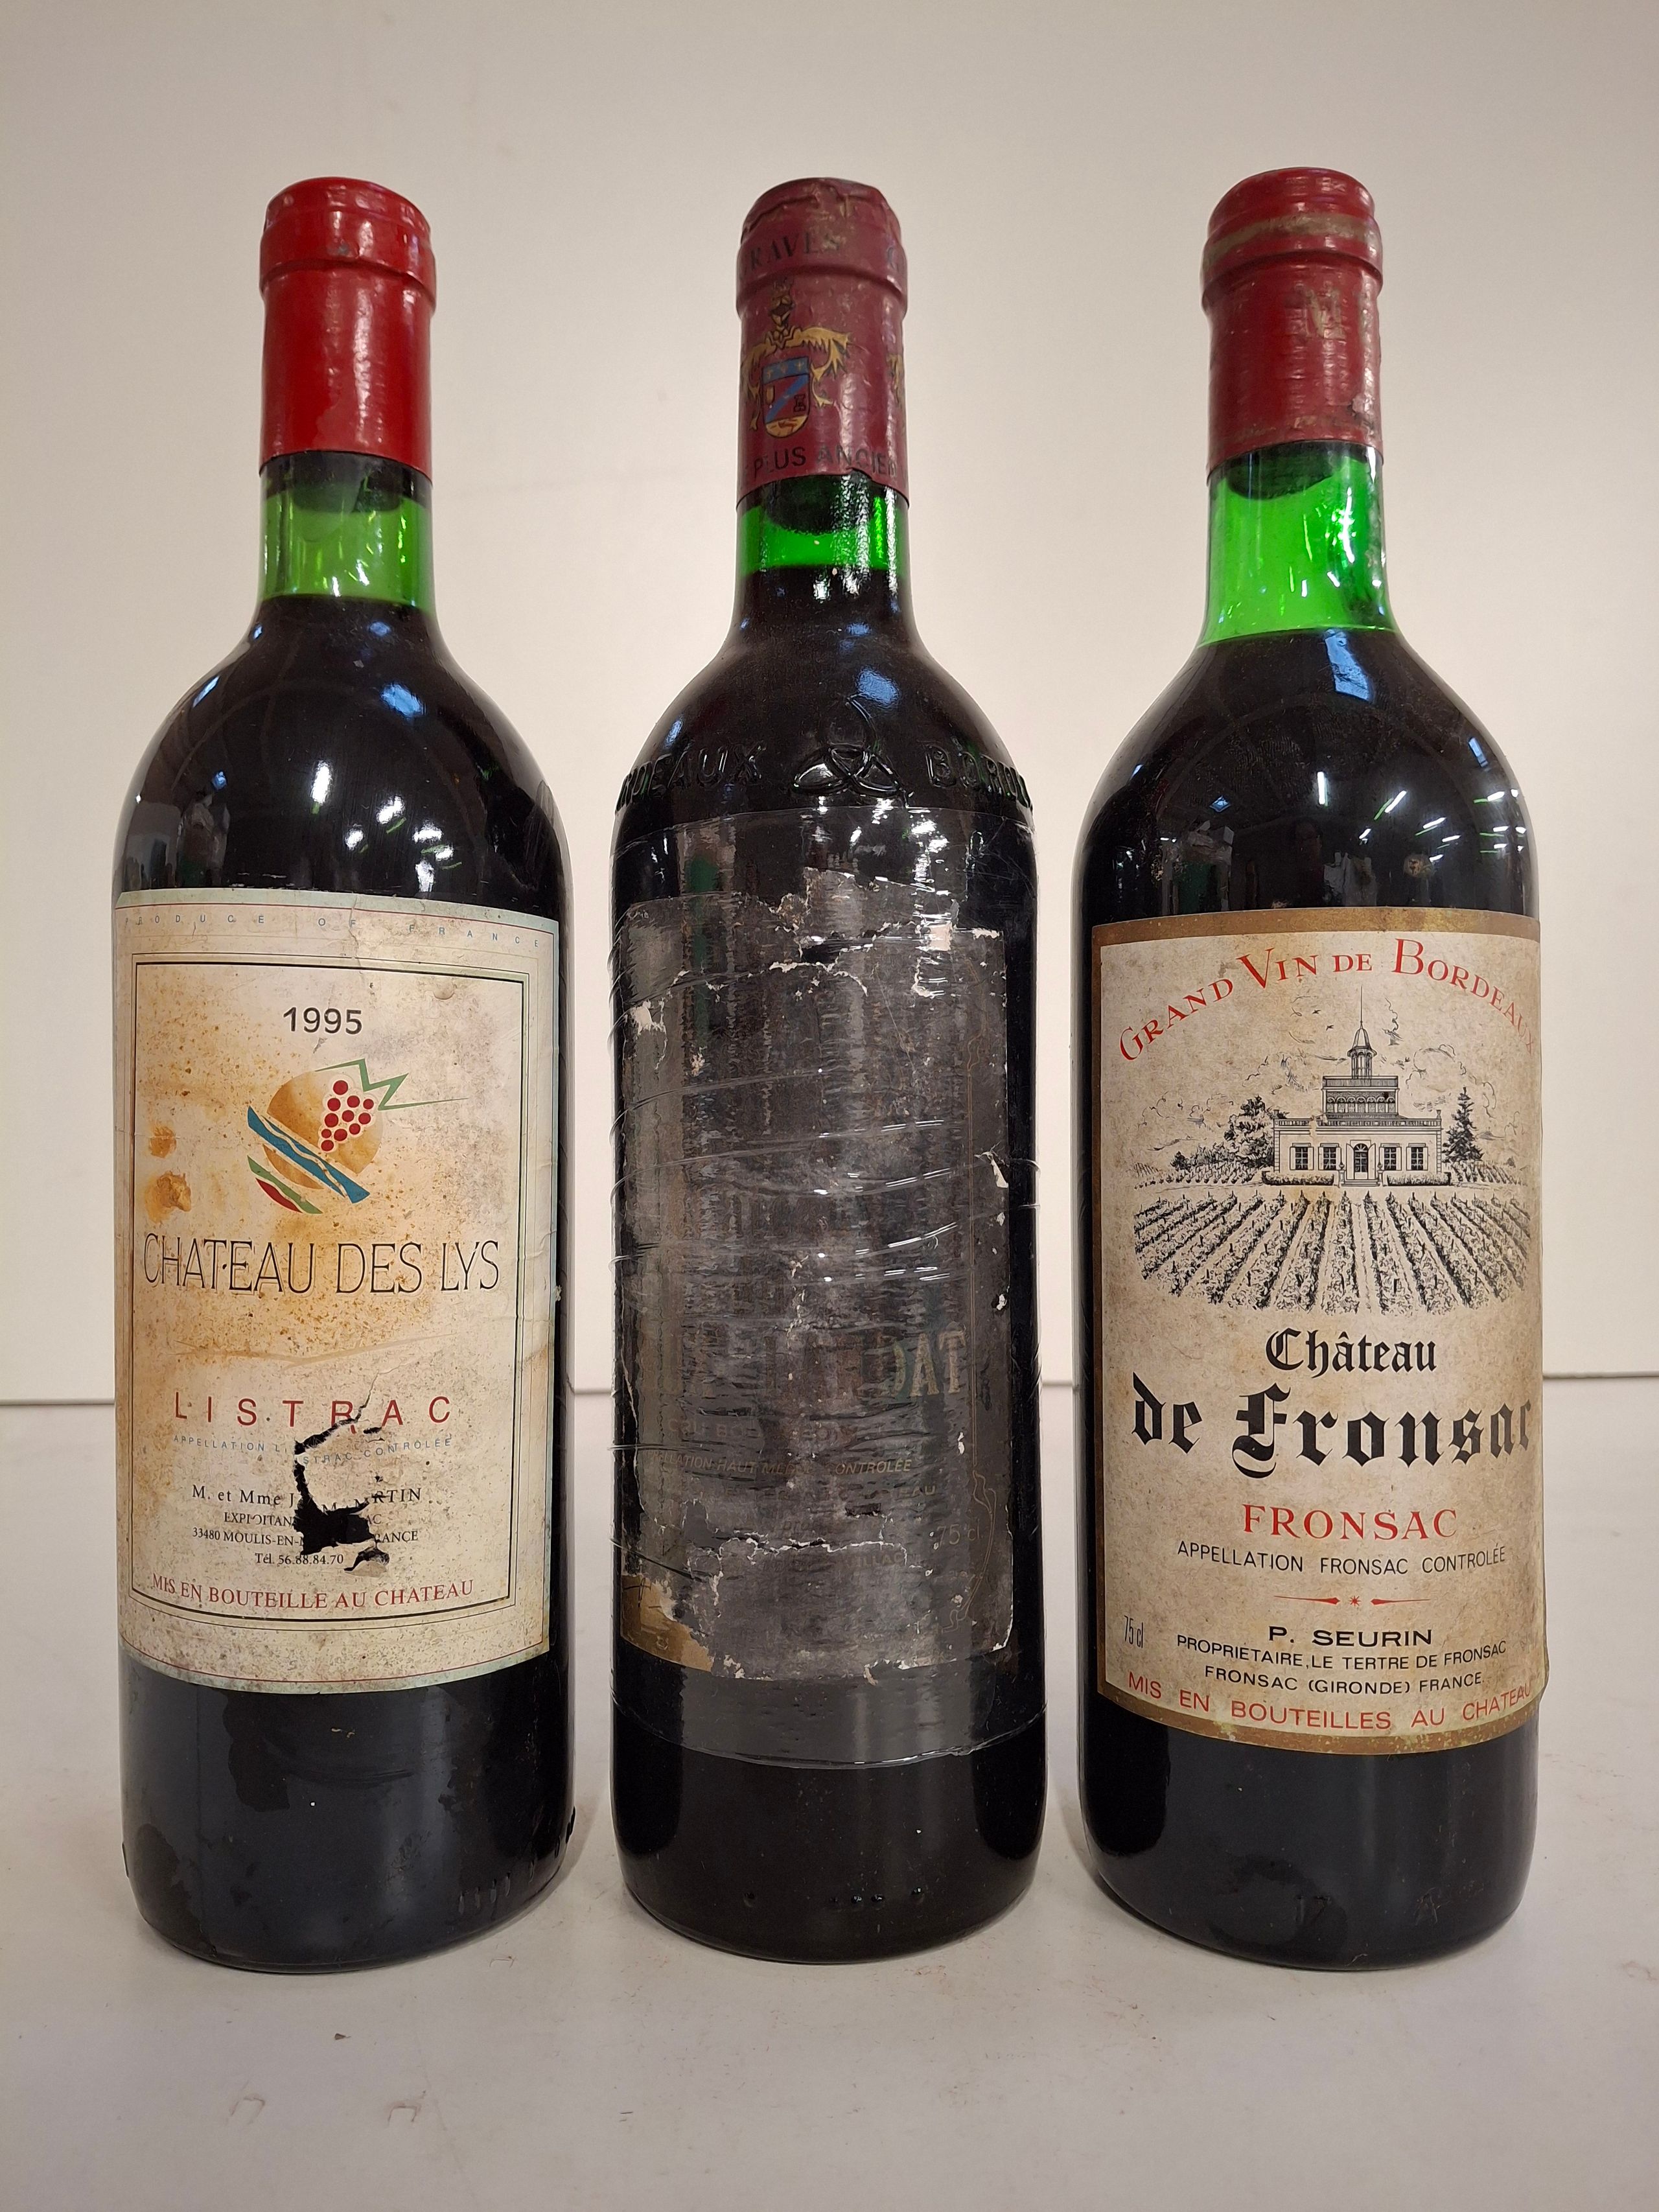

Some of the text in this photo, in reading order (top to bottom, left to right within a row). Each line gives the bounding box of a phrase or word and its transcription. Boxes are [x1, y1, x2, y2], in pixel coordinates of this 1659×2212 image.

[318, 917, 356, 928] OF
[408, 924, 539, 948] FRANCE
[1120, 938, 1534, 1060] GRAND VIN DE BORDEAUX
[283, 1006, 363, 1035] 1995
[143, 1233, 499, 1294] CHATEAU DES LYS
[1266, 1327, 1437, 1379] Château
[175, 1391, 451, 1434] LISTRAC
[1131, 1371, 1532, 1478] de Fronsac
[174, 1434, 265, 1452] APPELLATION
[192, 1484, 211, 1500] M.
[218, 1491, 232, 1502] et
[240, 1489, 282, 1506] Mme
[192, 1527, 220, 1541] 33480
[1242, 1503, 1457, 1541] FRONSAC
[278, 1554, 344, 1565] 56.88.84.70
[1177, 1540, 1506, 1575] APPELLATION FRONSAC CONTROLÉE
[153, 1573, 474, 1609] MIS EN BOUTEILLE AU CHATEAU
[1124, 1614, 1143, 1649] 75 cl
[1268, 1625, 1432, 1647] P. SEURIN
[1342, 1657, 1409, 1670] TERTRE
[1416, 1654, 1438, 1668] DE
[1444, 1640, 1507, 1666] FRONSAC
[1205, 1665, 1298, 1691] FRONSAC
[1308, 1679, 1411, 1695] (GIRONDE)
[1128, 1670, 1532, 1730] MIS EN BOUTEILLES AU CHATEAU
